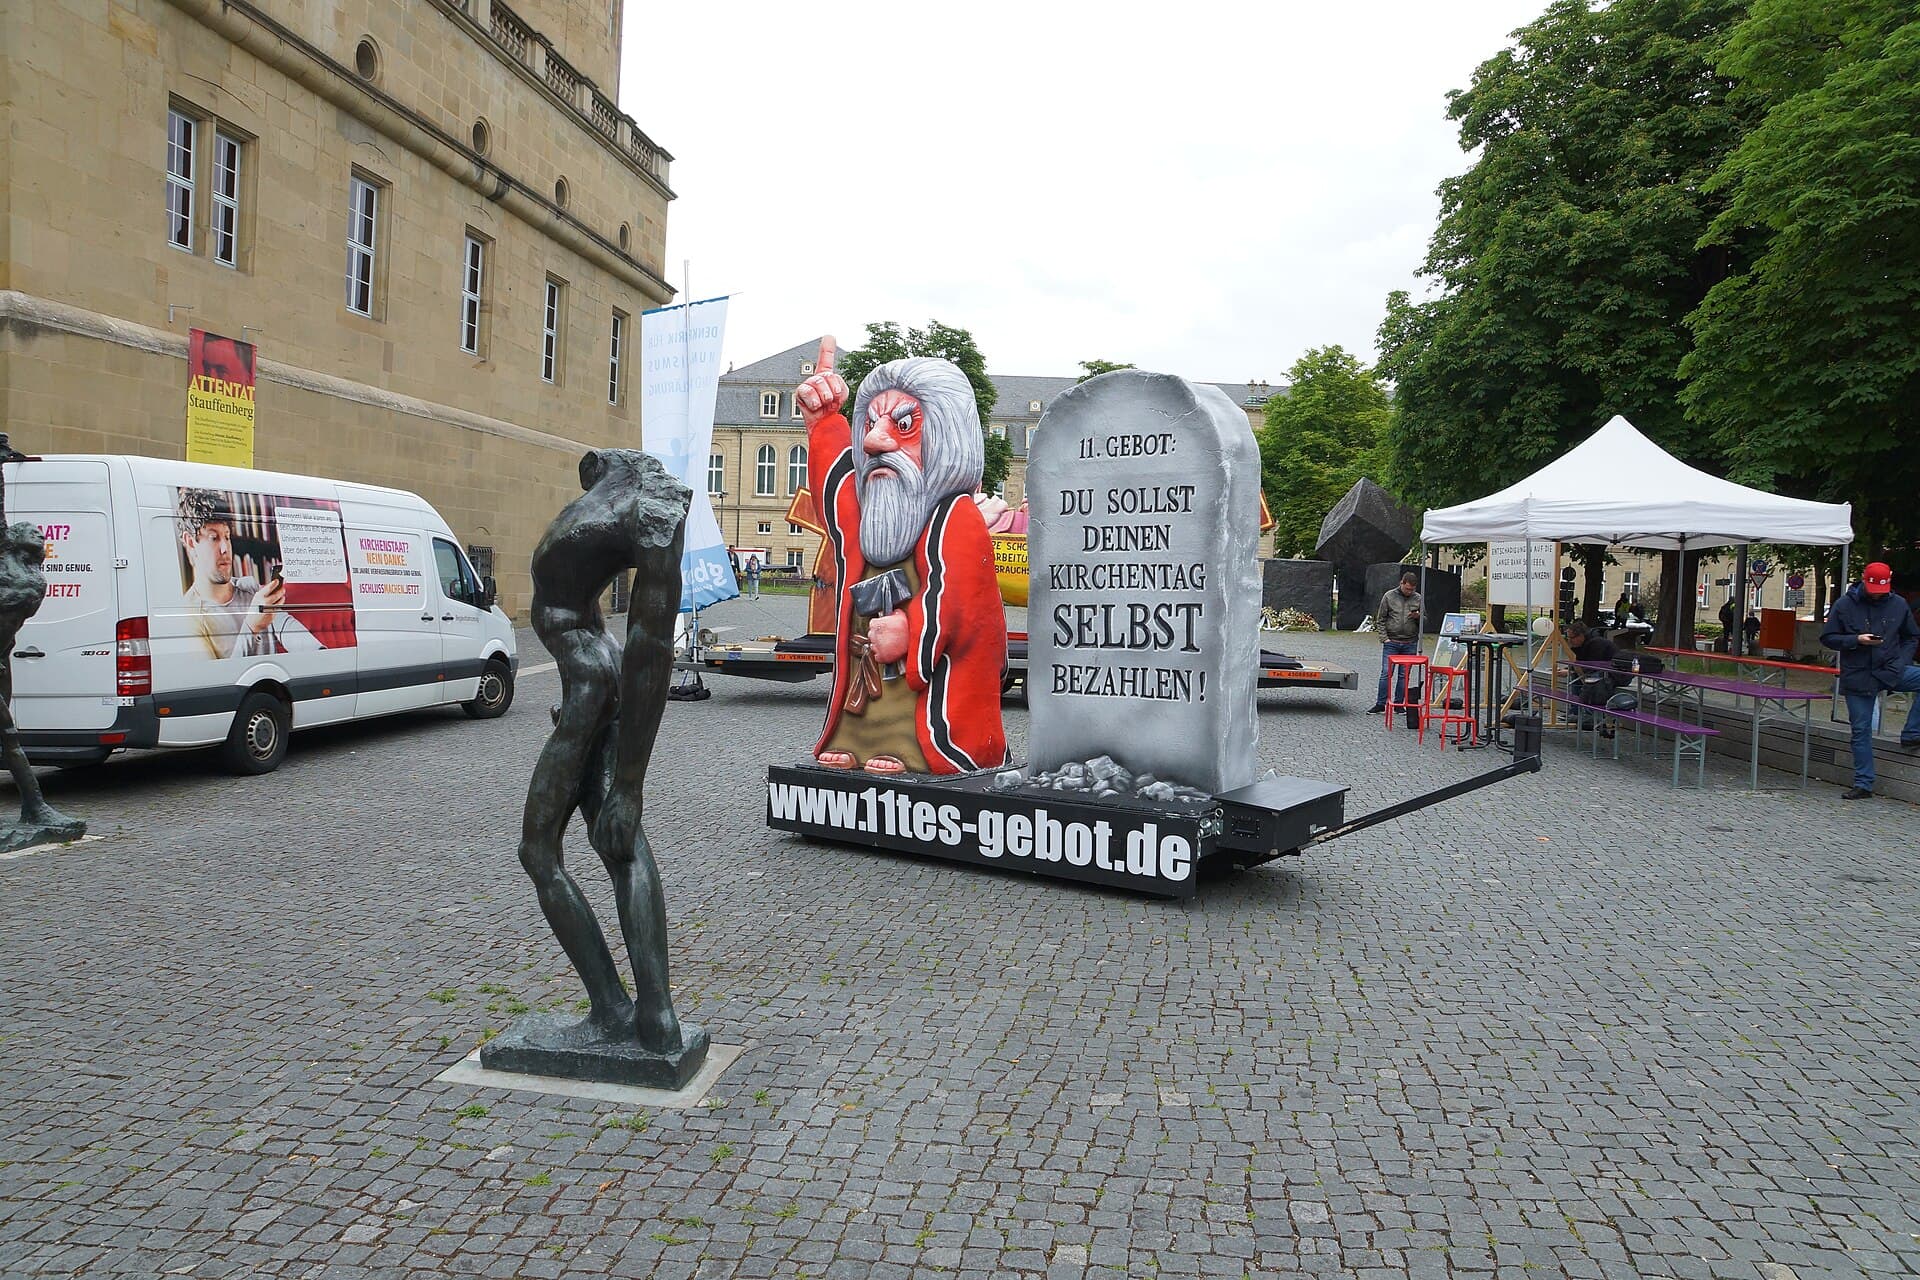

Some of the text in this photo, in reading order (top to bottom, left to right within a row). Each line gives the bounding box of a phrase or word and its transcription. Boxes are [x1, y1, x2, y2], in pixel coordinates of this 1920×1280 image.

[190, 374, 255, 401] ATTENTAT
[189, 394, 254, 421] Stauffenberg
[1079, 432, 1177, 459] 11. GEBOT:
[1060, 485, 1196, 516] DU SOLLST
[360, 538, 409, 554] KIRCHENSTAAT?
[1082, 524, 1171, 552] DEINEN
[46, 564, 63, 572] SIND
[65, 564, 93, 572] GENUG.
[366, 552, 407, 566] NEIN DANKE.
[1050, 564, 1206, 591] KIRCHENTAG
[1052, 602, 1203, 652] SELBST
[768, 781, 1192, 882] www.11tes-gebot.de
